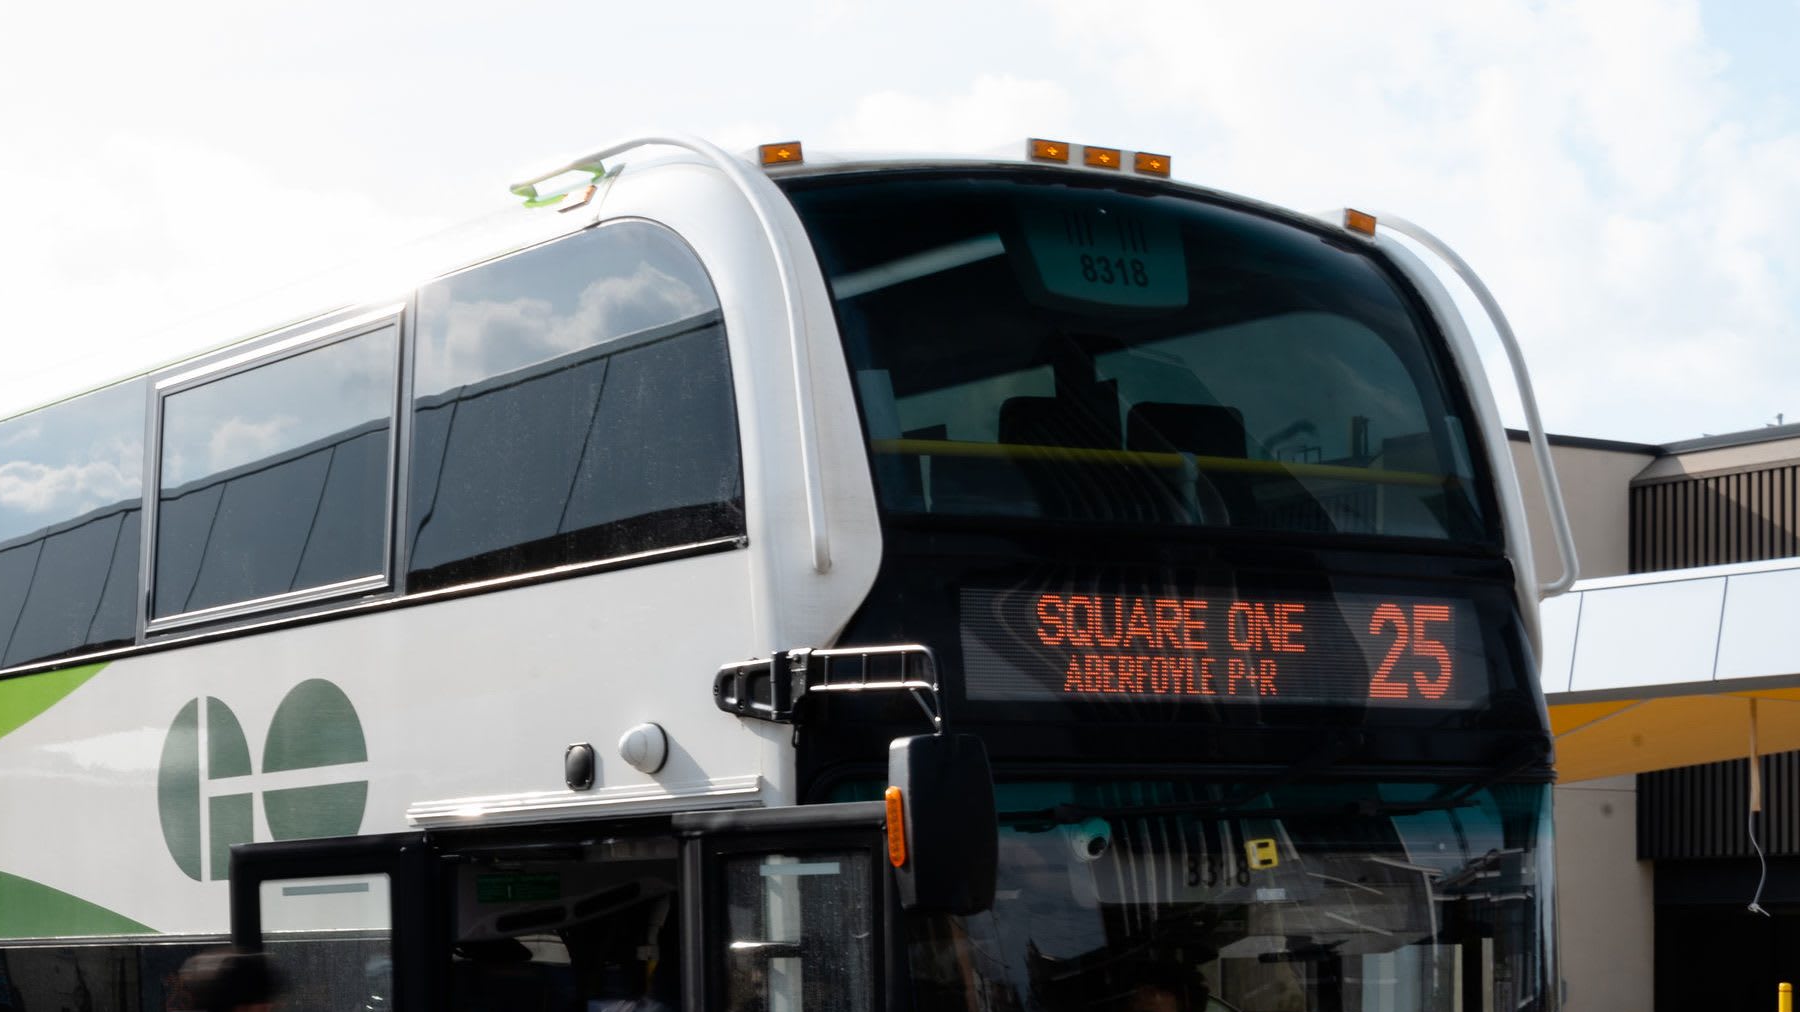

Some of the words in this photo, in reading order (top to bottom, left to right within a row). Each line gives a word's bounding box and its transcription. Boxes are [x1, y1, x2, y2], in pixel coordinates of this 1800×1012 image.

[1081, 253, 1148, 287] 8318
[1036, 594, 1208, 649] SQUARE
[1227, 602, 1306, 652] ONE
[1064, 655, 1216, 695] ABERFOYLE
[1228, 659, 1278, 695] P+R
[1368, 603, 1453, 699] 25
